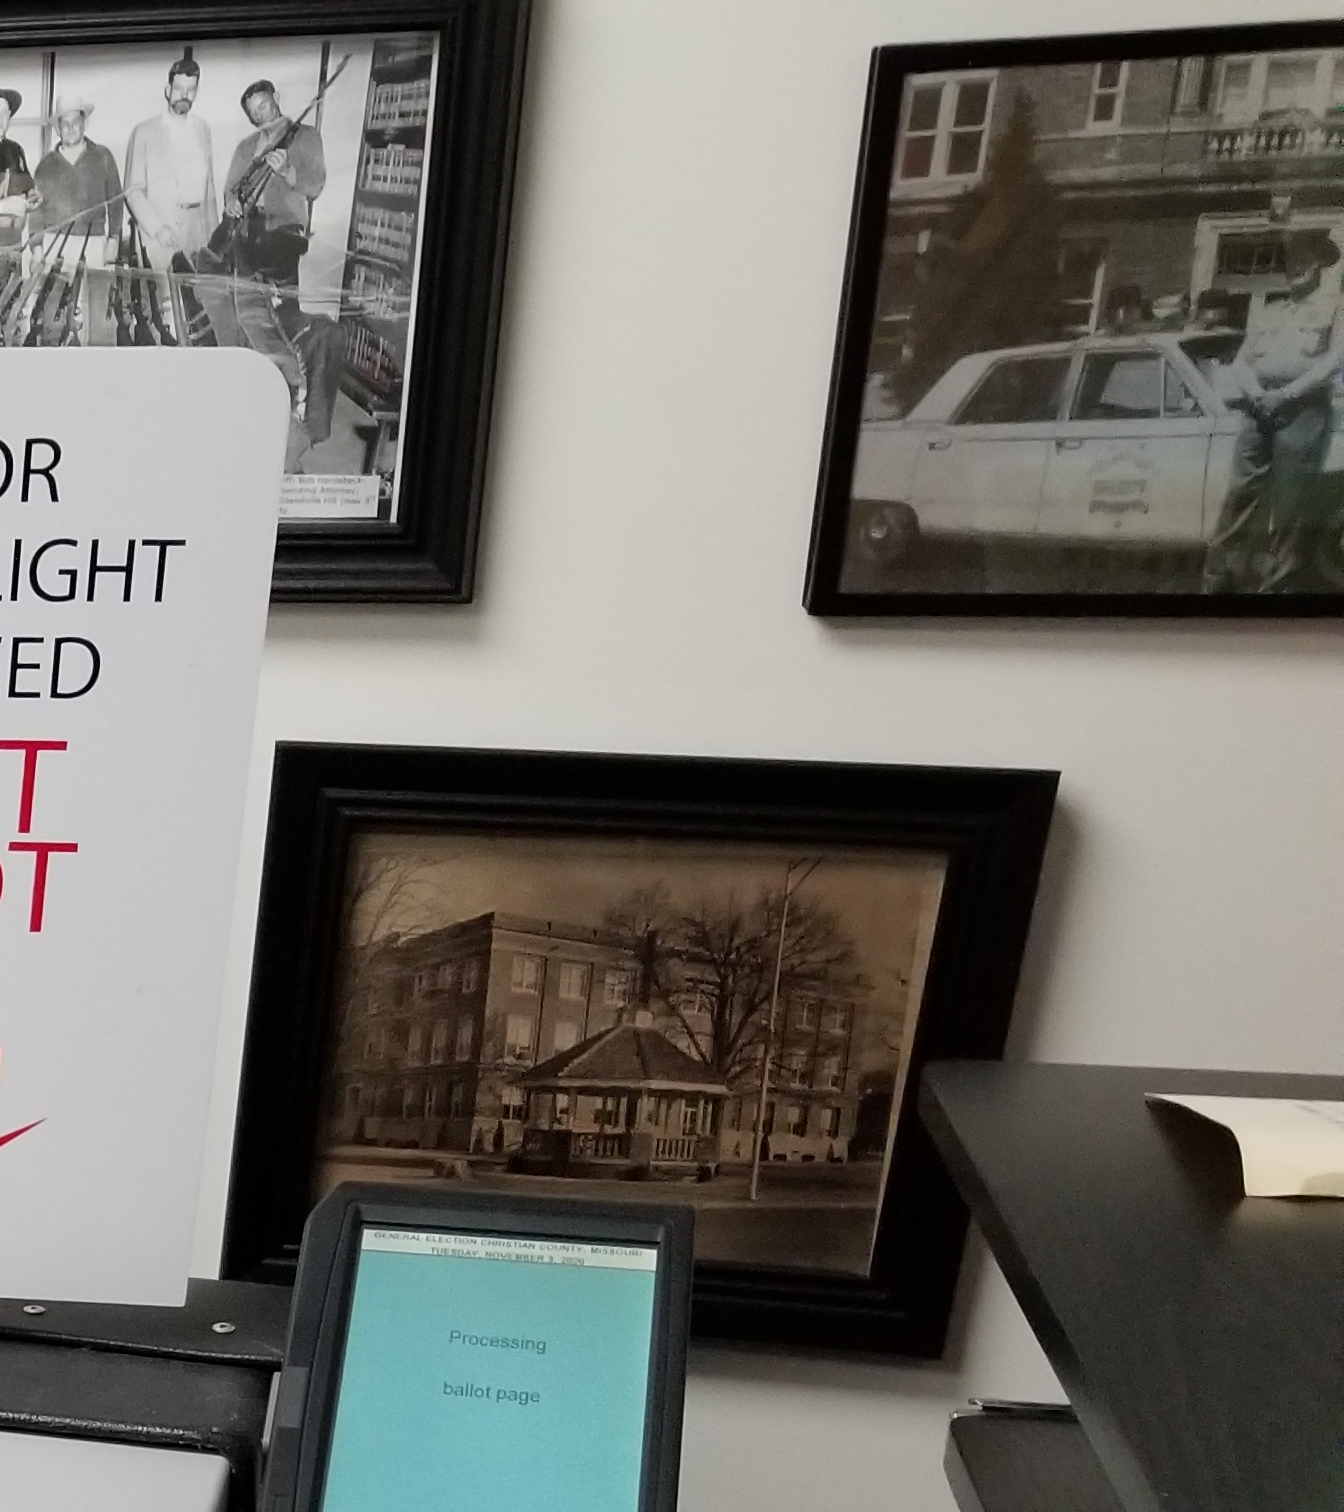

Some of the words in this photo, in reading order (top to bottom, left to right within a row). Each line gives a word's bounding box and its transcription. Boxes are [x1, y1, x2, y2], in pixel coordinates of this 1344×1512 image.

[373, 1231, 421, 1243] GENERAL
[425, 1235, 478, 1246] ELECTION
[480, 1239, 536, 1251] CHRISTIAN
[539, 1243, 583, 1255] COUNTY,
[590, 1246, 644, 1258] MISSOURI
[430, 1246, 482, 1260] TUESDAY,
[485, 1251, 545, 1264] NOVEMBER
[561, 1257, 585, 1267] 2020
[449, 1329, 547, 1355] Processing
[442, 1381, 491, 1401] ballot
[495, 1386, 541, 1406] page
